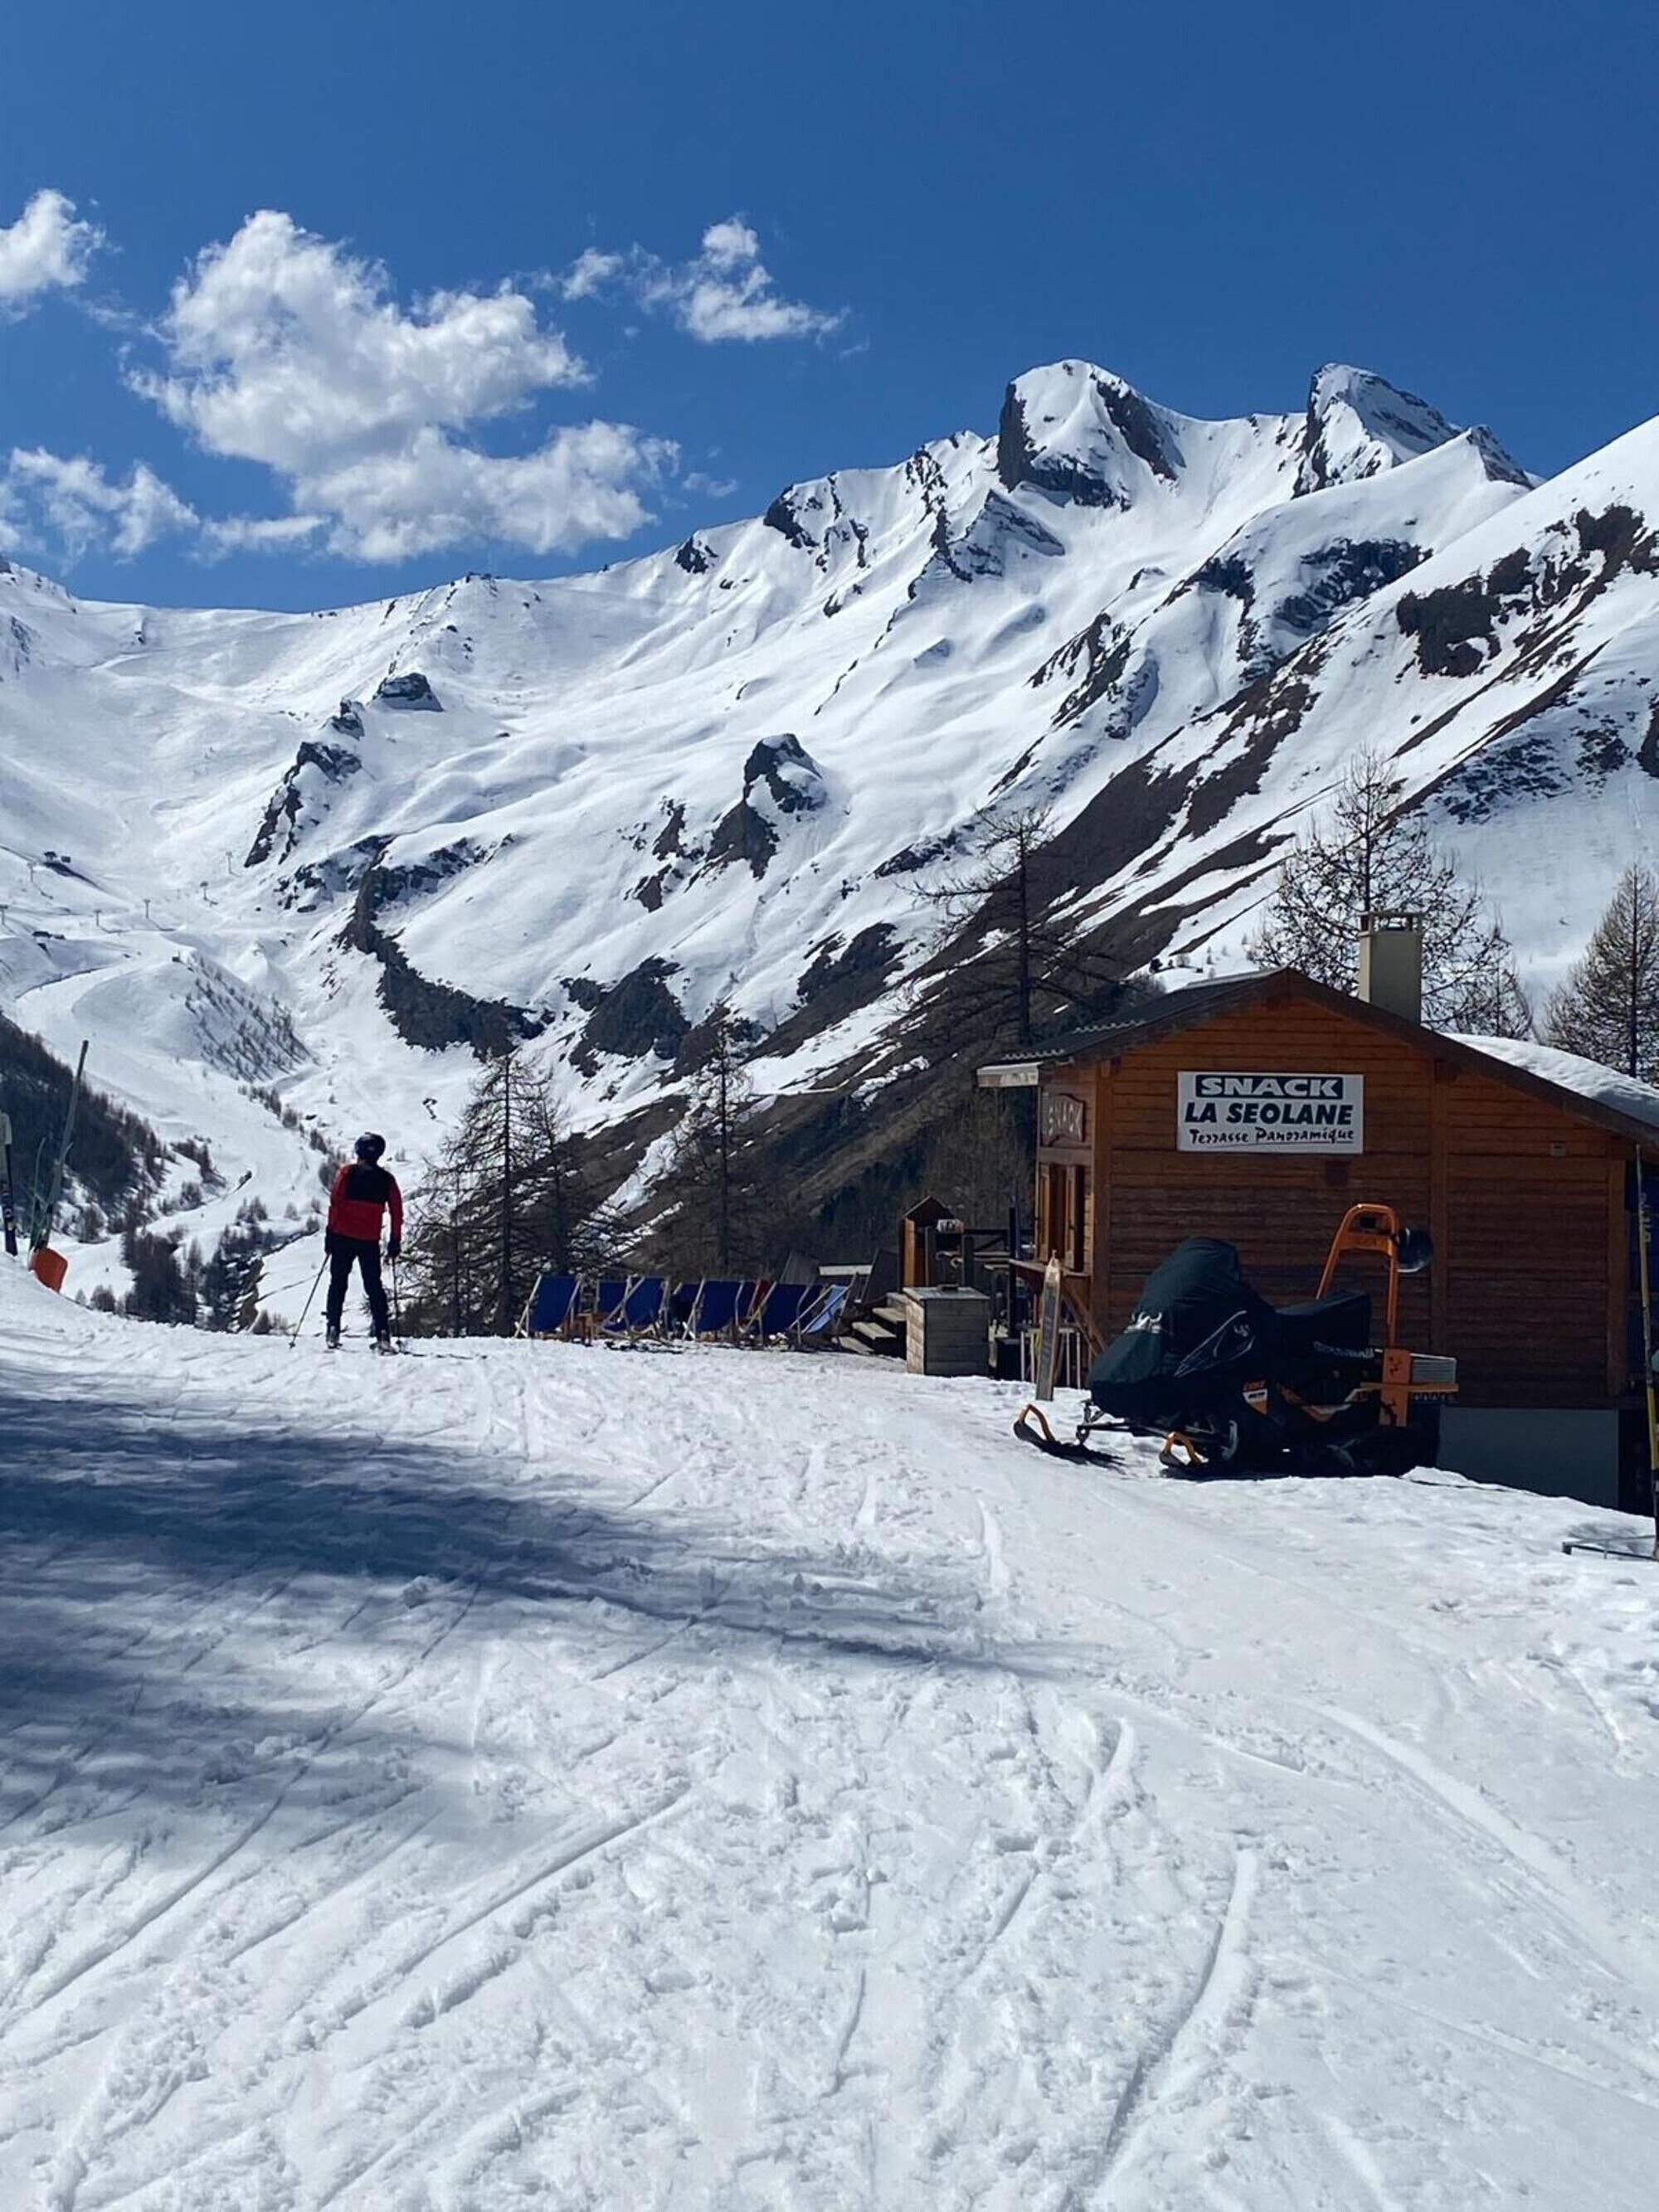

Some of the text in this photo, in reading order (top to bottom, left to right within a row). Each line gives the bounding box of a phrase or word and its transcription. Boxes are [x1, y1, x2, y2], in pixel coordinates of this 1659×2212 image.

[1201, 1078, 1338, 1096] SNACK
[1185, 1102, 1354, 1125] LA SEOLANE
